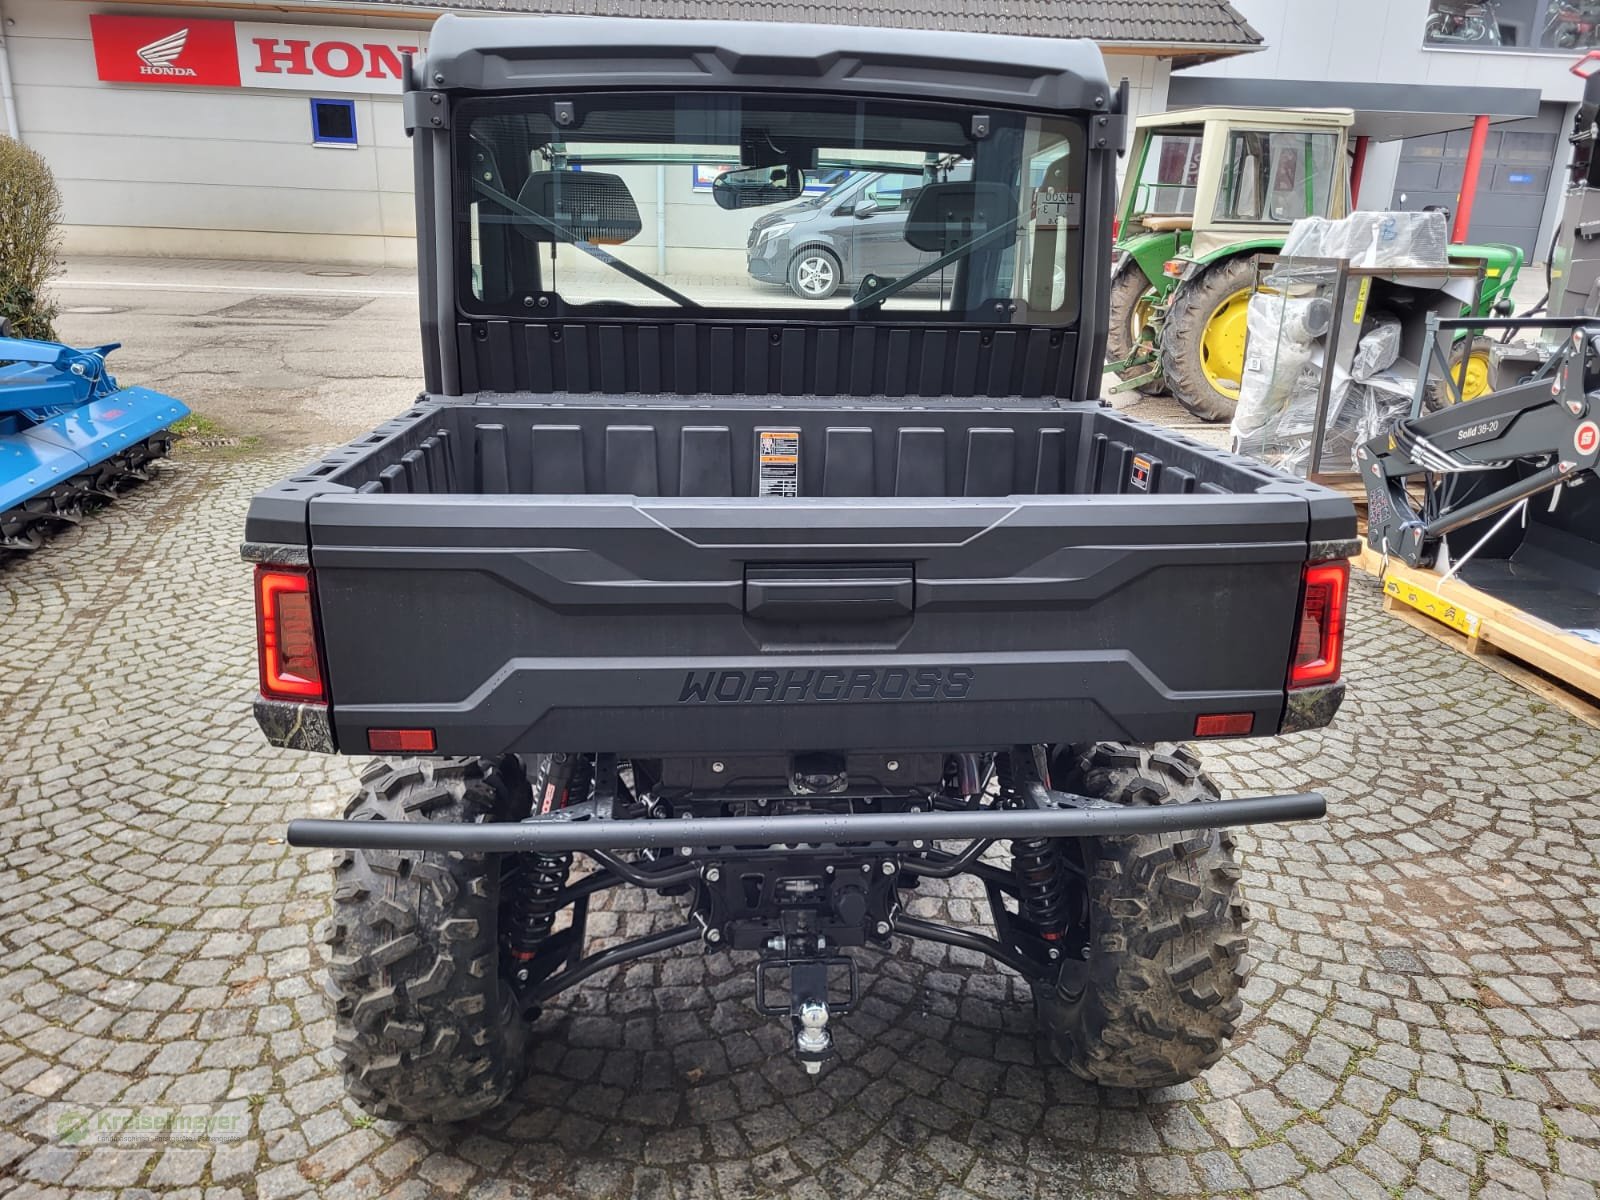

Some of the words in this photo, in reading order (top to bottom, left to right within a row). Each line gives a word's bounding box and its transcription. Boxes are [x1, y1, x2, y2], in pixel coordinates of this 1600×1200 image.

[252, 38, 427, 78] HON
[140, 66, 196, 77] HONDA
[1457, 426, 1477, 440] Solid
[679, 667, 975, 703] WORKCROSS
